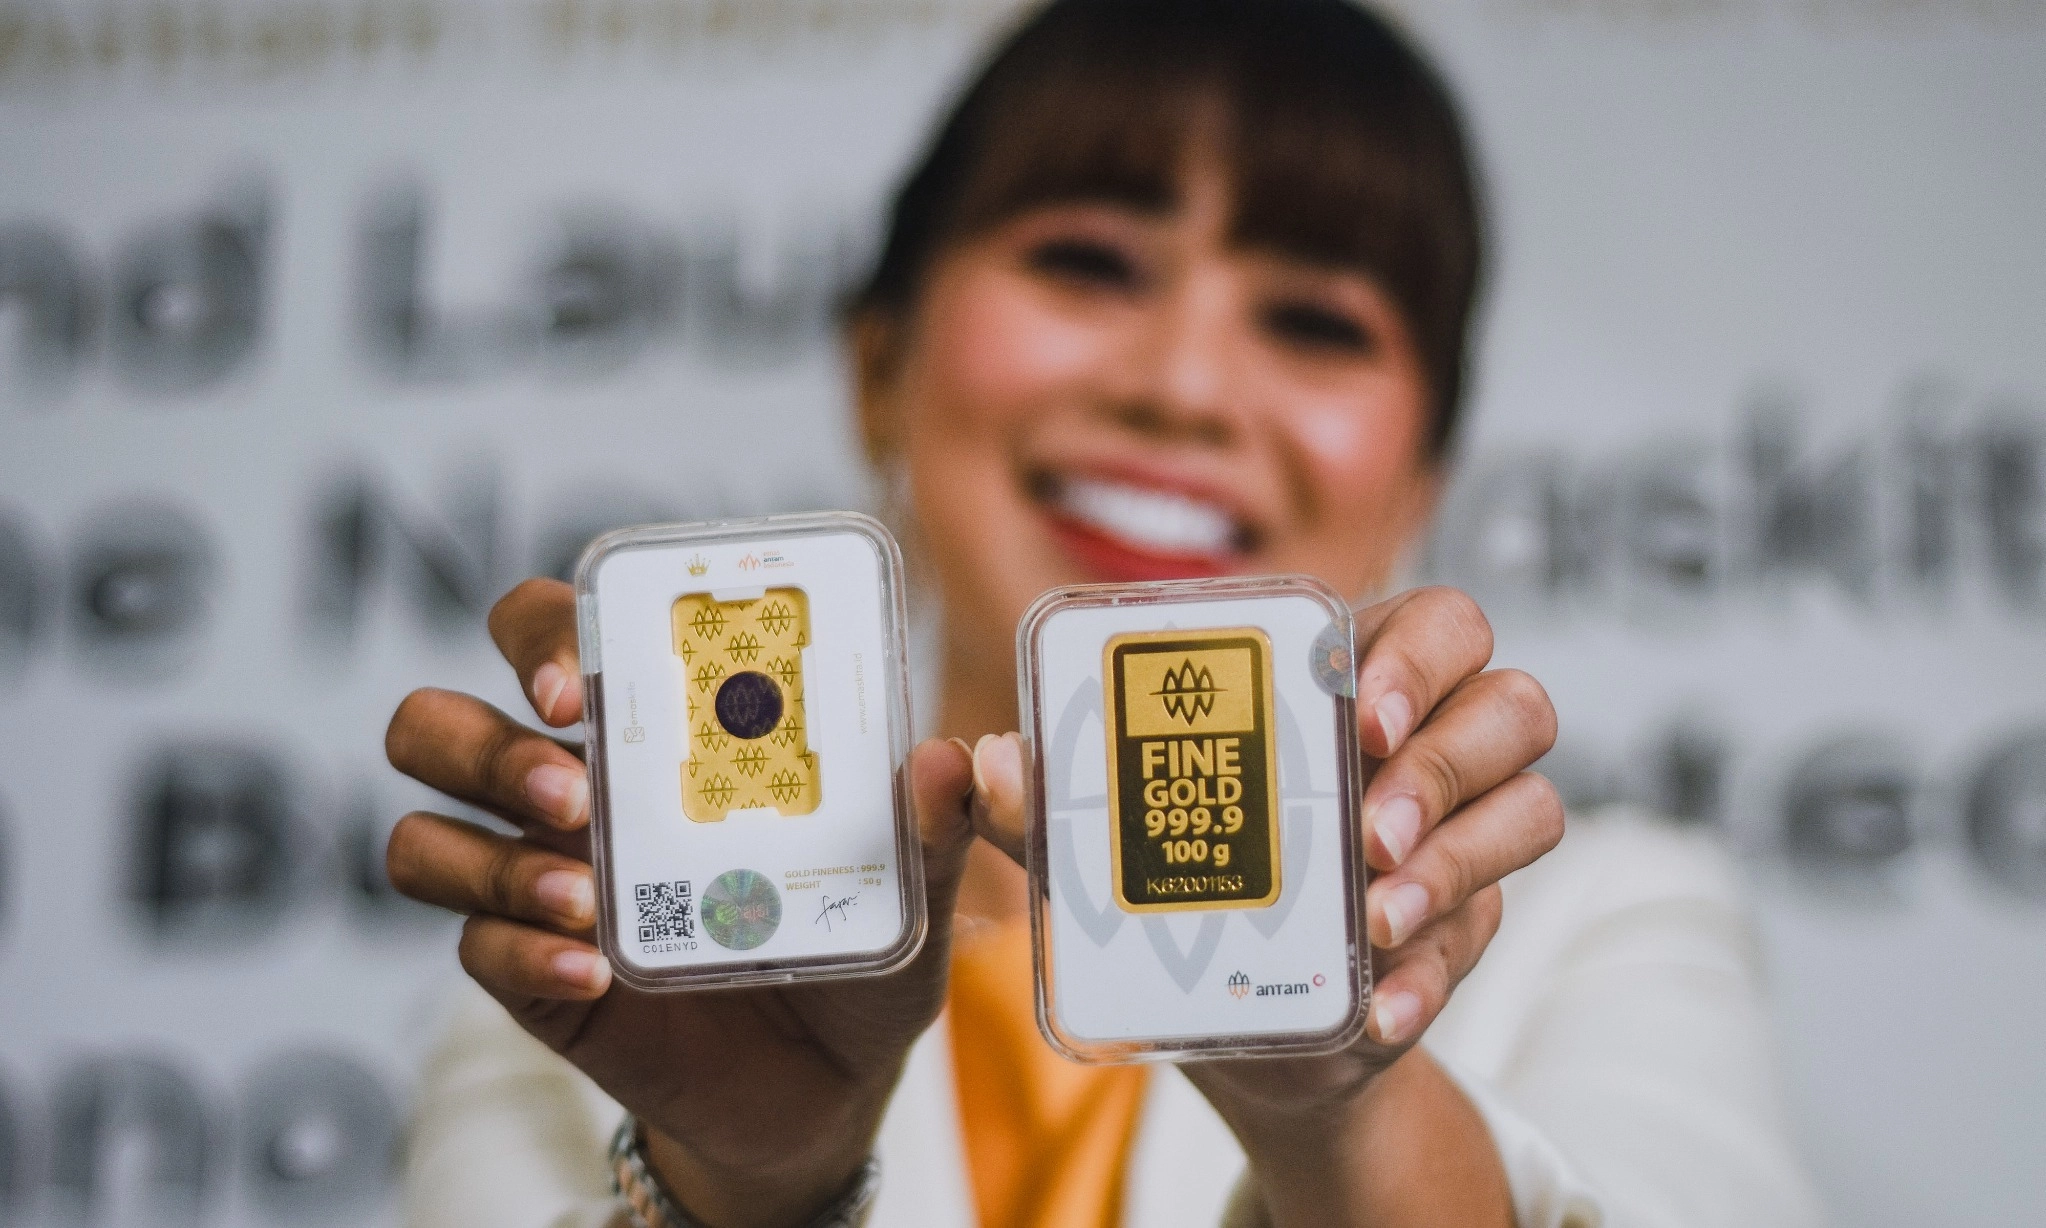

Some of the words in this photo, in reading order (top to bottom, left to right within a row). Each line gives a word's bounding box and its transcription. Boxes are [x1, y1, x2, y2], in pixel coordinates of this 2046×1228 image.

[1141, 738, 1241, 779] FINE
[1143, 776, 1242, 808] GOLD
[1144, 805, 1244, 837] 999.9
[1161, 839, 1208, 863] 100
[1212, 843, 1230, 867] g
[785, 869, 810, 878] GOLD
[812, 865, 855, 876] FINENESS
[861, 863, 886, 872] 999.9
[786, 880, 821, 891] WEIGHT
[863, 877, 874, 885] 50
[1256, 983, 1309, 996] antam
